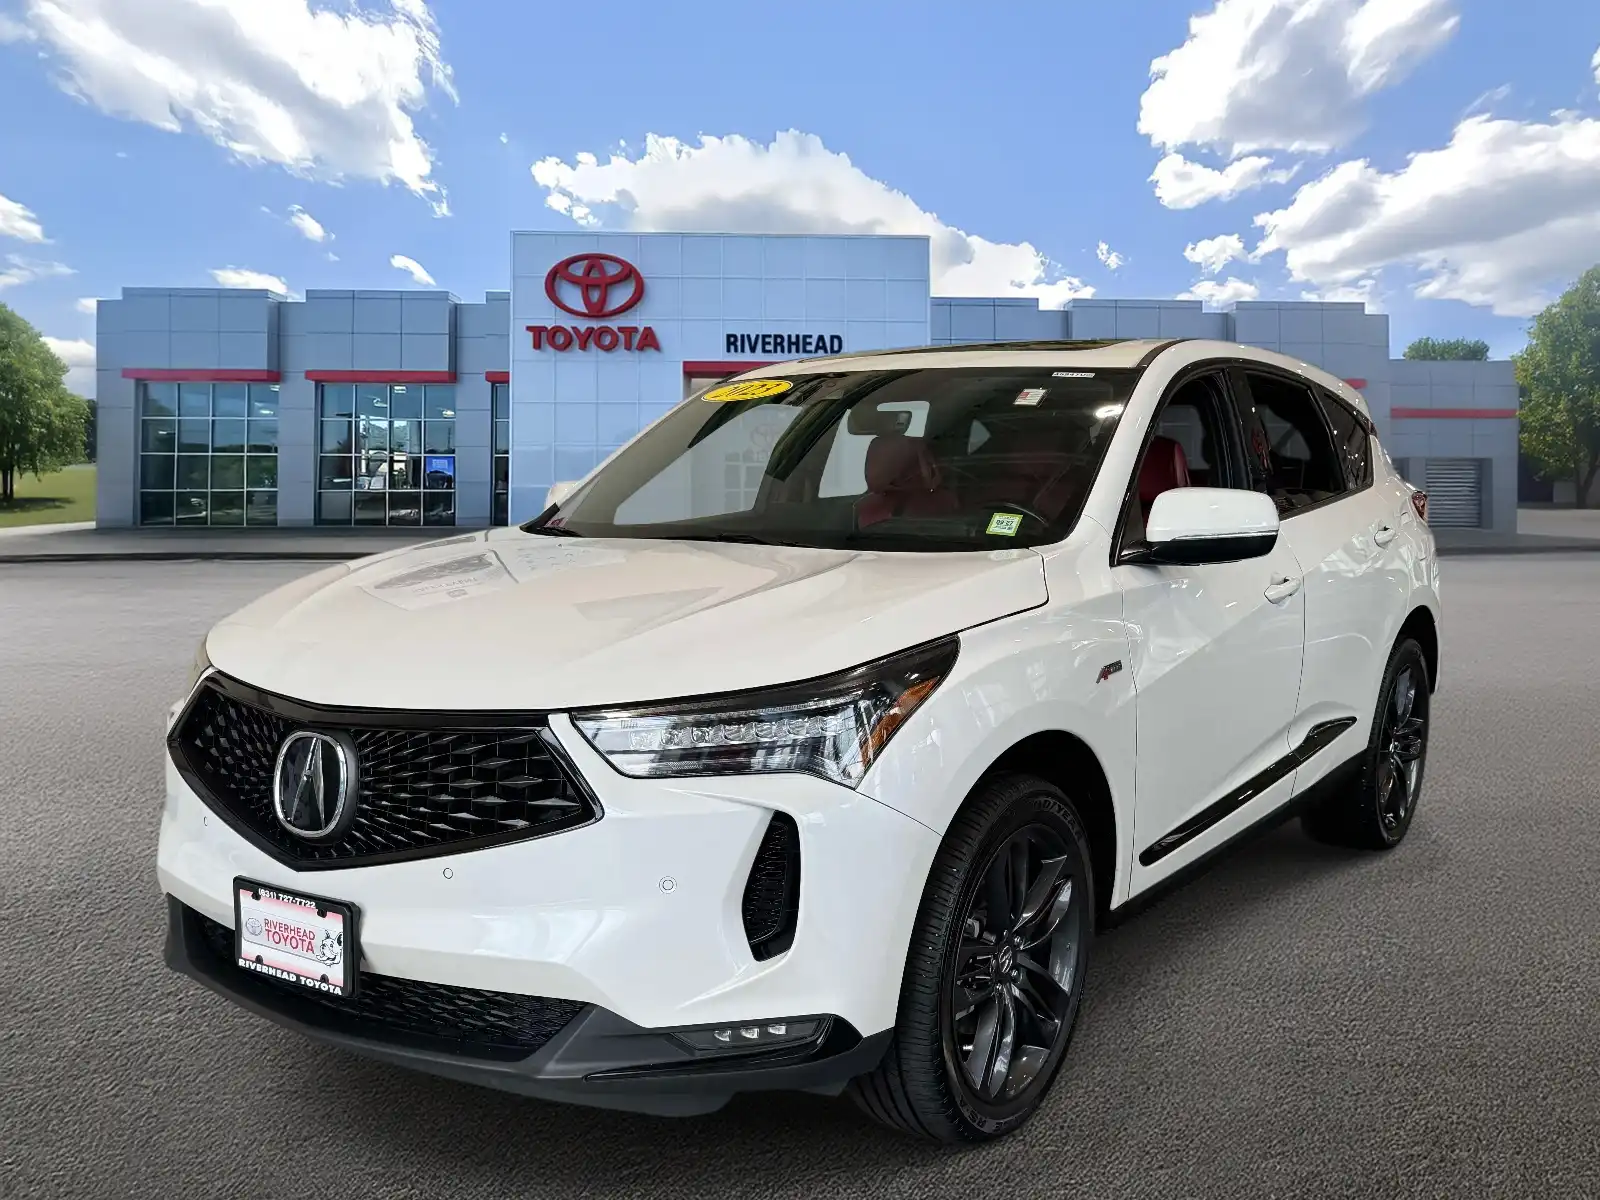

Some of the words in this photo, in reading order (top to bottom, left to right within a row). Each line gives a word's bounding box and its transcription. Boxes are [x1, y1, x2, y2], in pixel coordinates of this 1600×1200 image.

[525, 325, 662, 353] TOYOTA
[725, 333, 844, 355] RIVERHEAD
[278, 893, 317, 909] 727-7722
[264, 918, 316, 941] RIVERHEAD
[265, 928, 316, 955] TOYOTA
[238, 958, 297, 982] RIVERHEAD
[300, 976, 342, 996] TOYOTA
